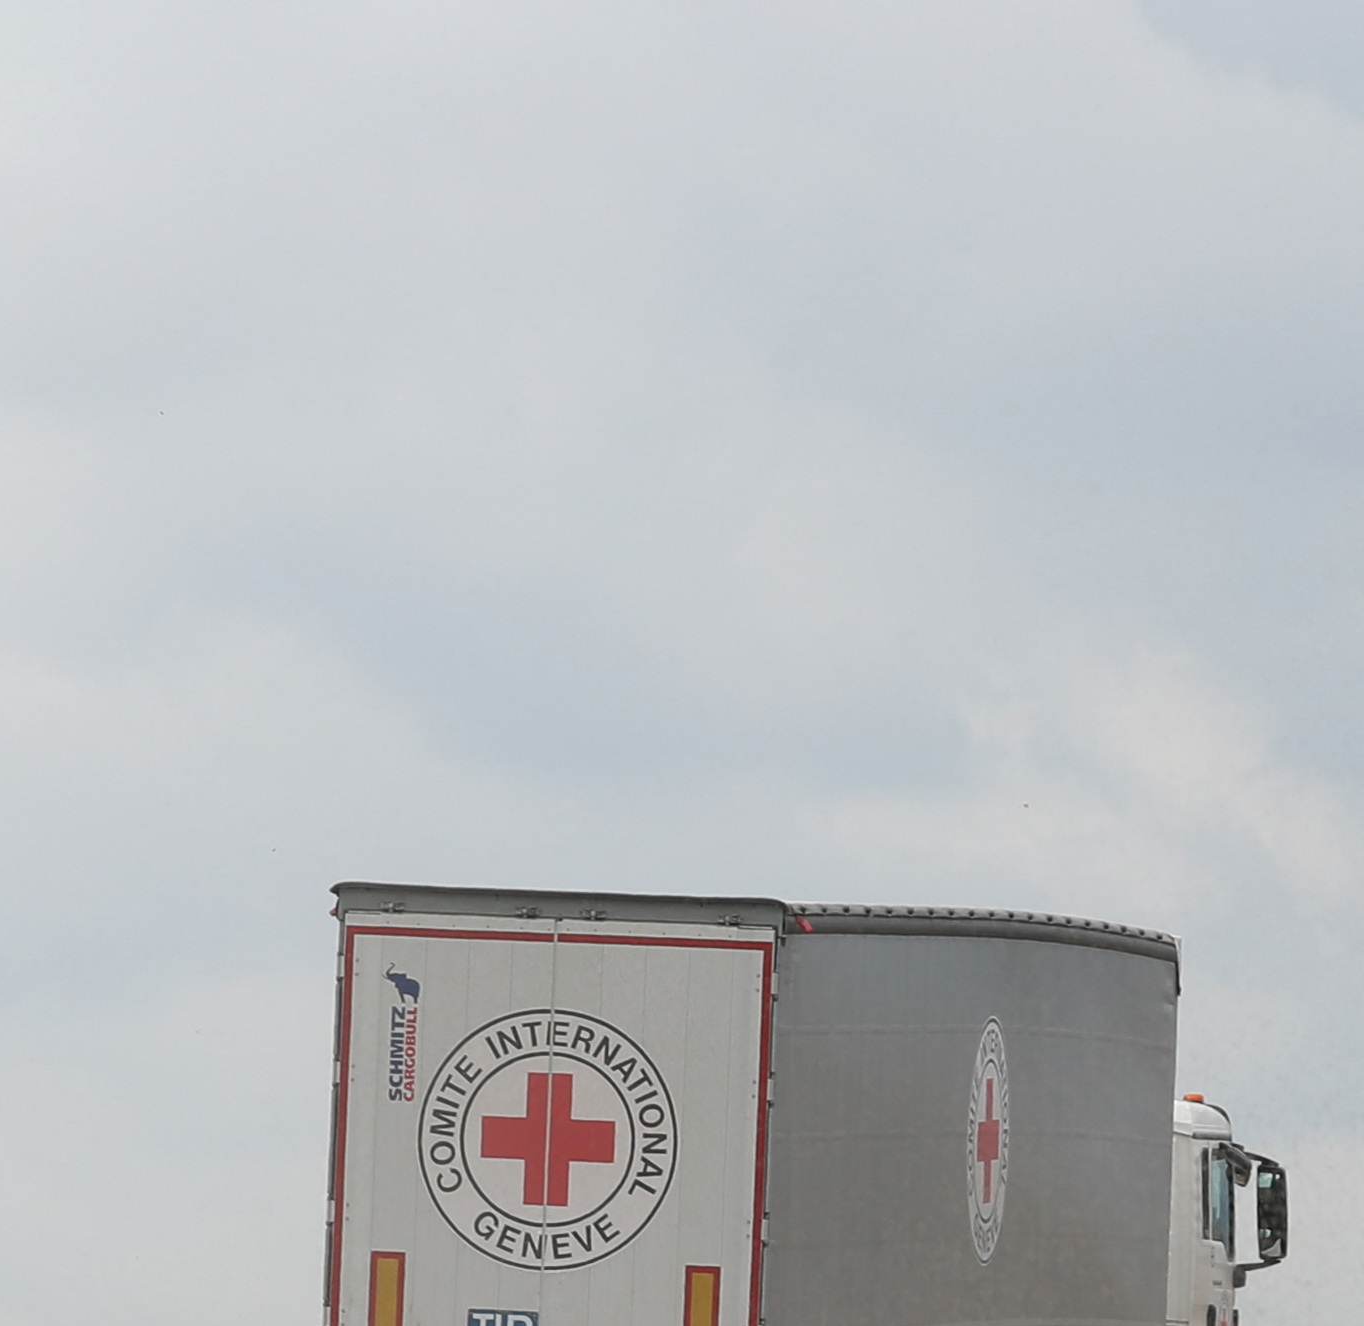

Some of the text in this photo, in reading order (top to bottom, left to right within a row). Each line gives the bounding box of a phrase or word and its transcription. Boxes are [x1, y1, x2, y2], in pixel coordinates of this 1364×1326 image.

[388, 1006, 405, 1101] SCHMITZ
[403, 1007, 417, 1101] CARGOBULL
[429, 1021, 668, 1196] COMITE INTERNATIONAL
[474, 1211, 621, 1260] GENEVE
